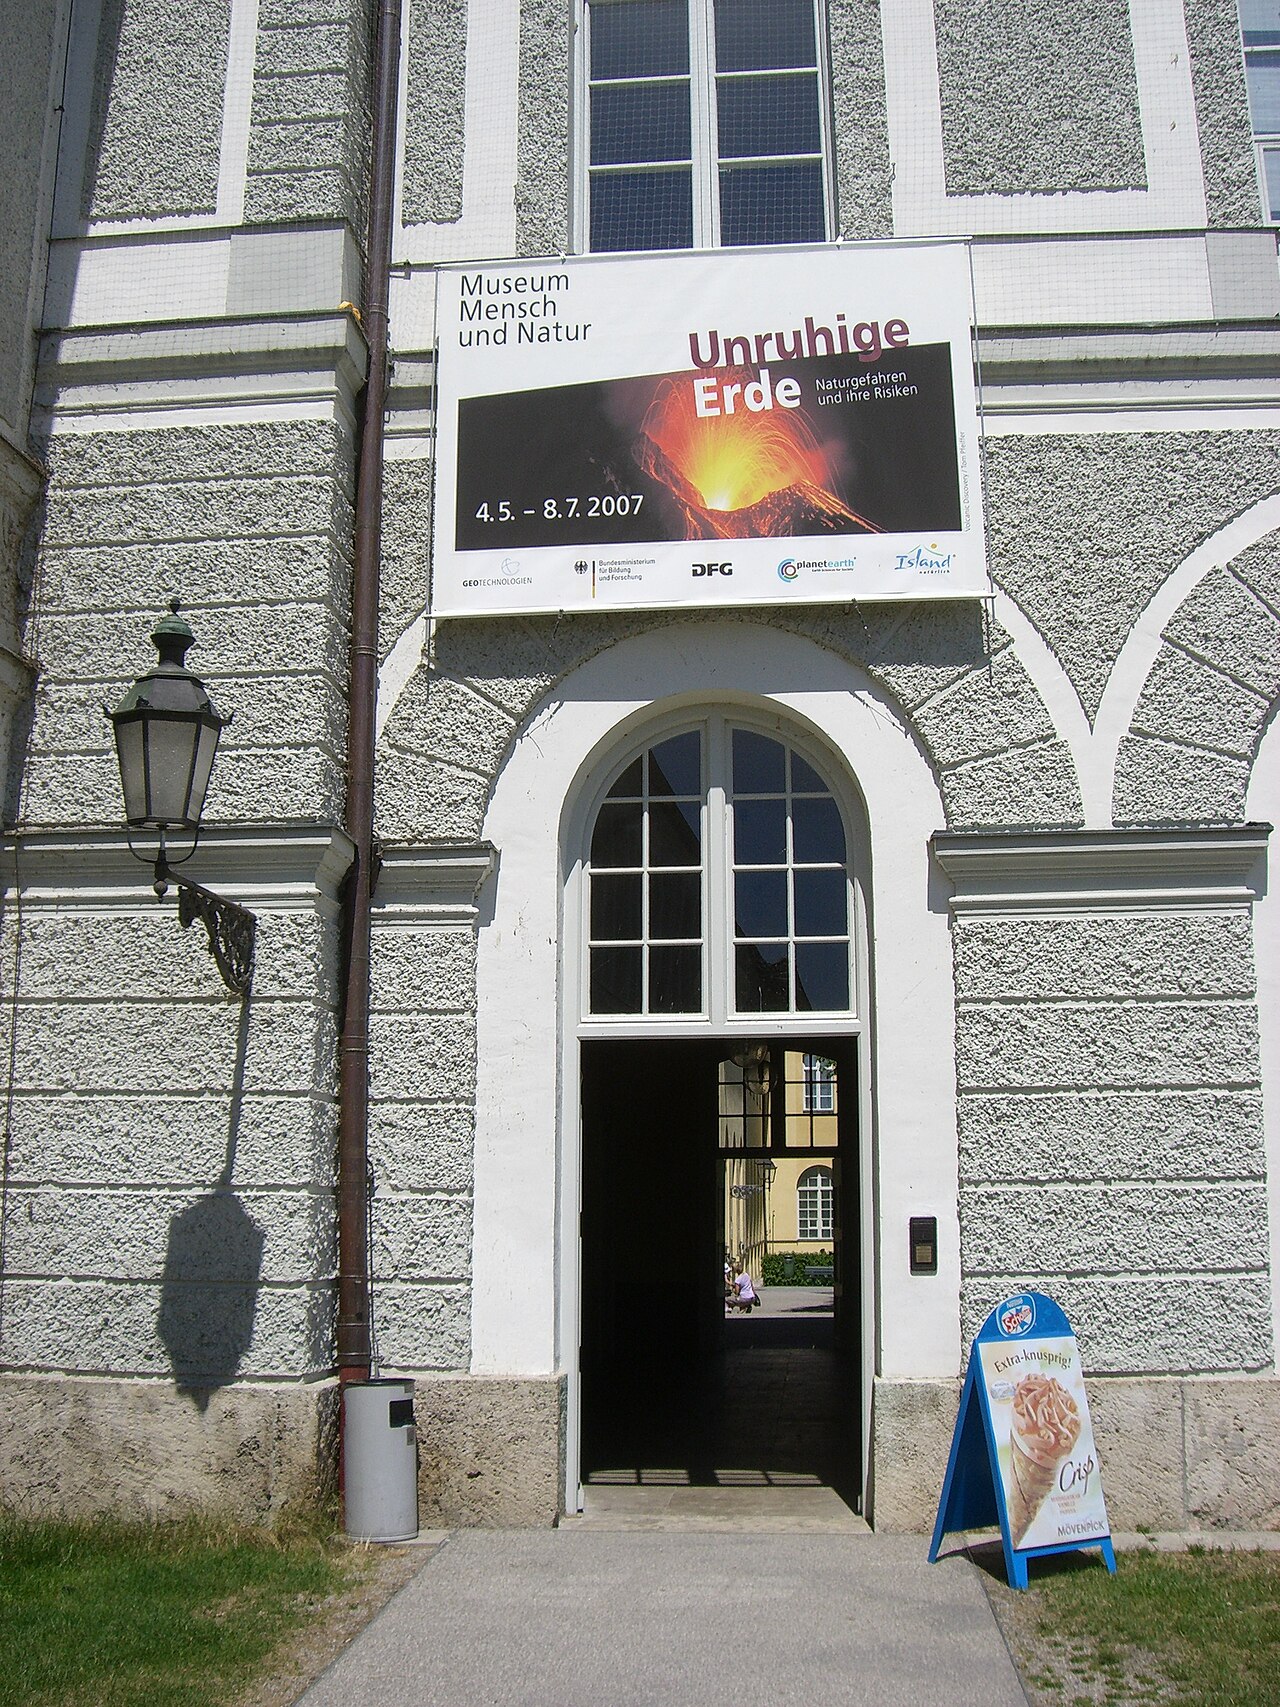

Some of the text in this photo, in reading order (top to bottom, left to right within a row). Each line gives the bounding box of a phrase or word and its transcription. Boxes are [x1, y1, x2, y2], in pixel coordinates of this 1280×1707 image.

[461, 274, 569, 296] Museum
[460, 294, 557, 321] Mensch
[459, 322, 592, 347] und Natur
[689, 313, 910, 369] Unruhige
[694, 368, 802, 418] Erde
[815, 371, 907, 393] Naturgefahren
[817, 383, 919, 406] und ihre Risiken
[962, 474, 971, 504] Discovery
[587, 495, 644, 517] 2007
[598, 558, 656, 567] Bundesministerium
[608, 566, 632, 574] Bildung
[691, 562, 733, 577] DFG
[894, 548, 951, 570] Island
[462, 577, 533, 588] GEOTECHNOLOGIEN
[993, 1348, 1073, 1374] Extra-knusprig!
[1060, 1454, 1094, 1496] Crisp
[1057, 1519, 1105, 1537] MÖVENPICK
